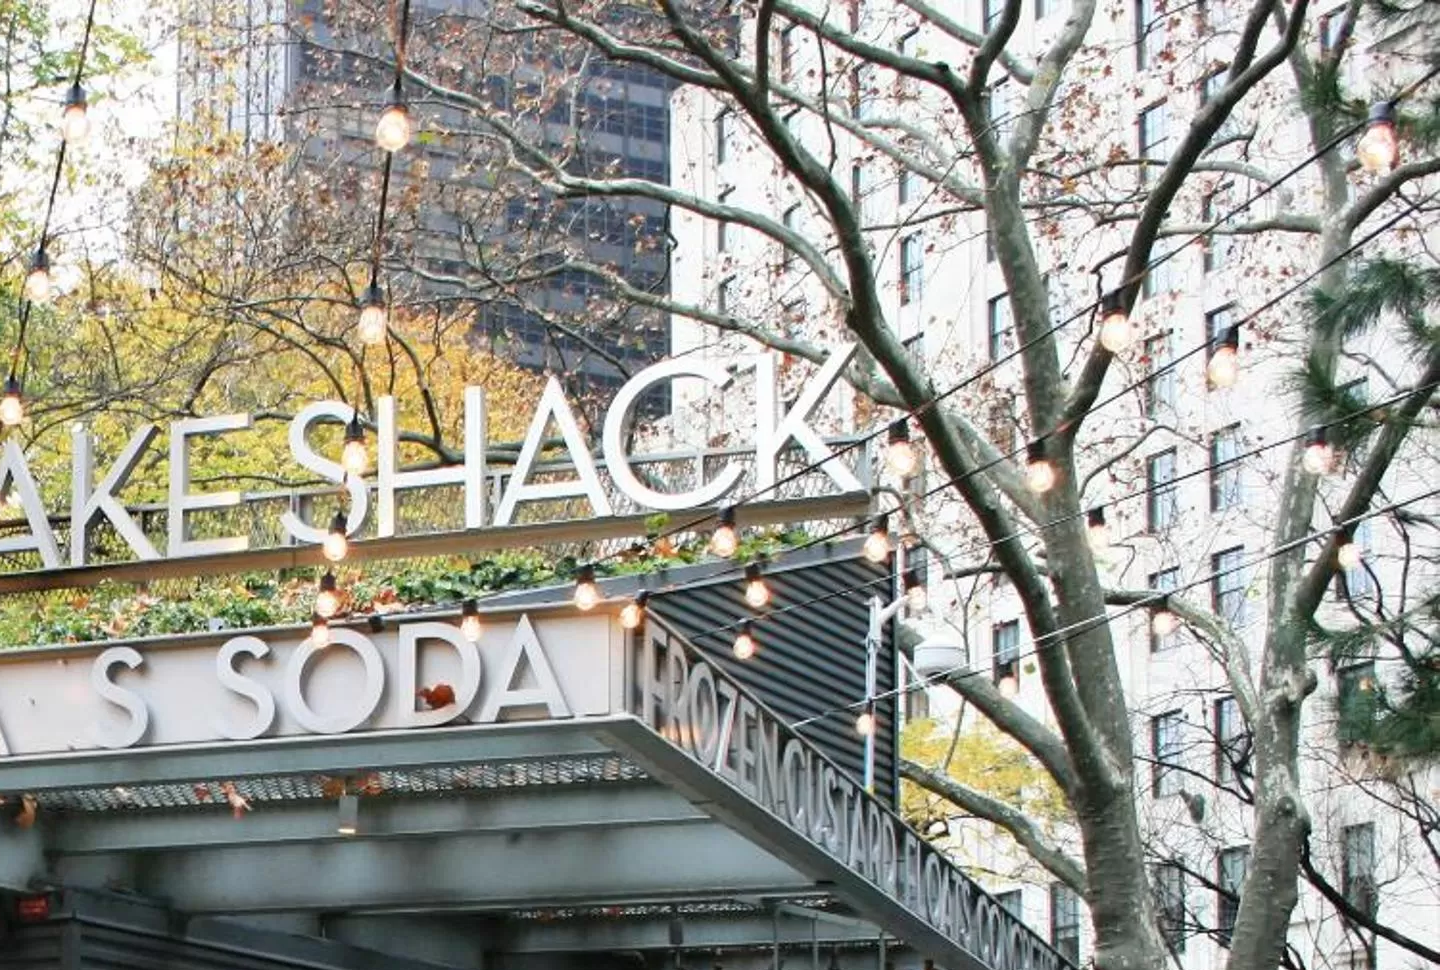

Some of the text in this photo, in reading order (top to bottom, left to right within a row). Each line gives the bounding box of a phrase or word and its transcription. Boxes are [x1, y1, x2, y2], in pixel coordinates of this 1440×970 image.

[281, 341, 866, 544] SHACK
[212, 613, 575, 740] SODA
[643, 616, 779, 817] FROZEN
[782, 738, 897, 893] CUSTARD
